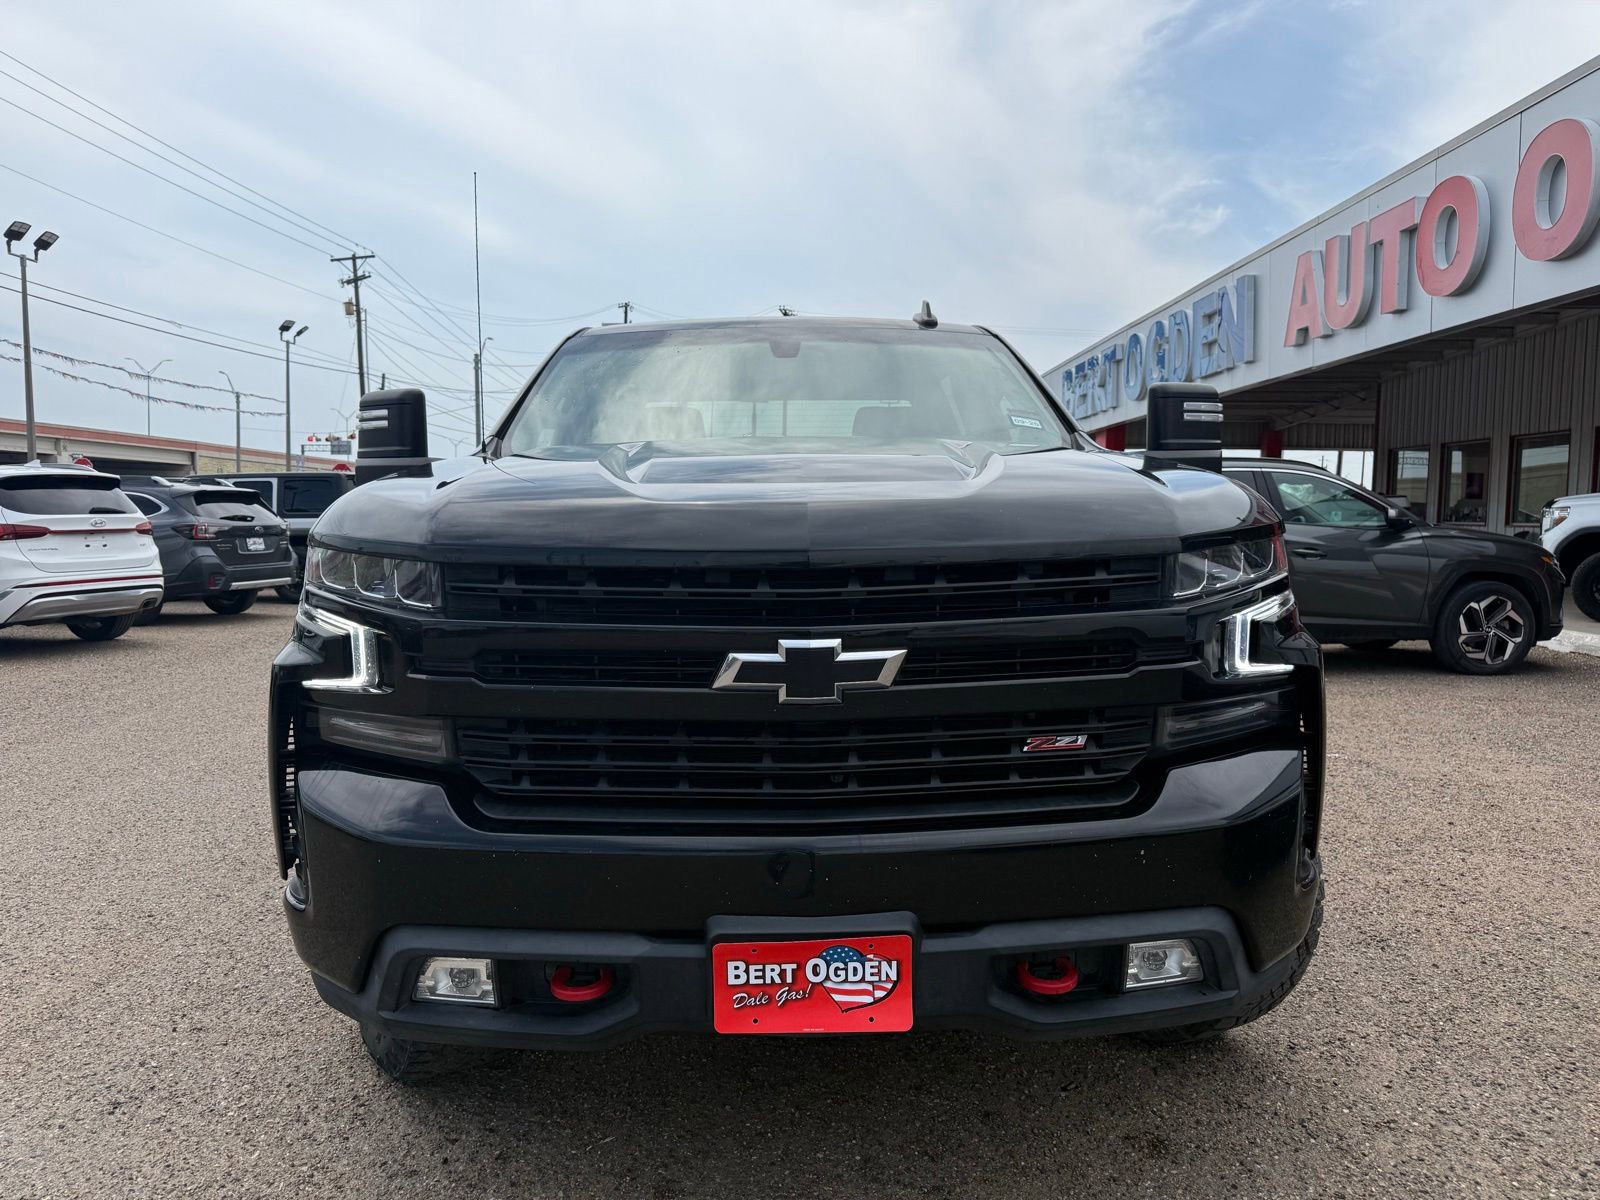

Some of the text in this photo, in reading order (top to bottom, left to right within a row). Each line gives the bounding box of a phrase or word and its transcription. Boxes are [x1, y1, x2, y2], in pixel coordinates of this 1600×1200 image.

[1062, 343, 1124, 420] BERT
[1123, 275, 1256, 401] OGDEN
[1284, 174, 1491, 347] AUTO
[1023, 735, 1088, 752] Z71
[727, 957, 898, 986] BERT OGDEN
[732, 983, 813, 1009] Dale Gas!
